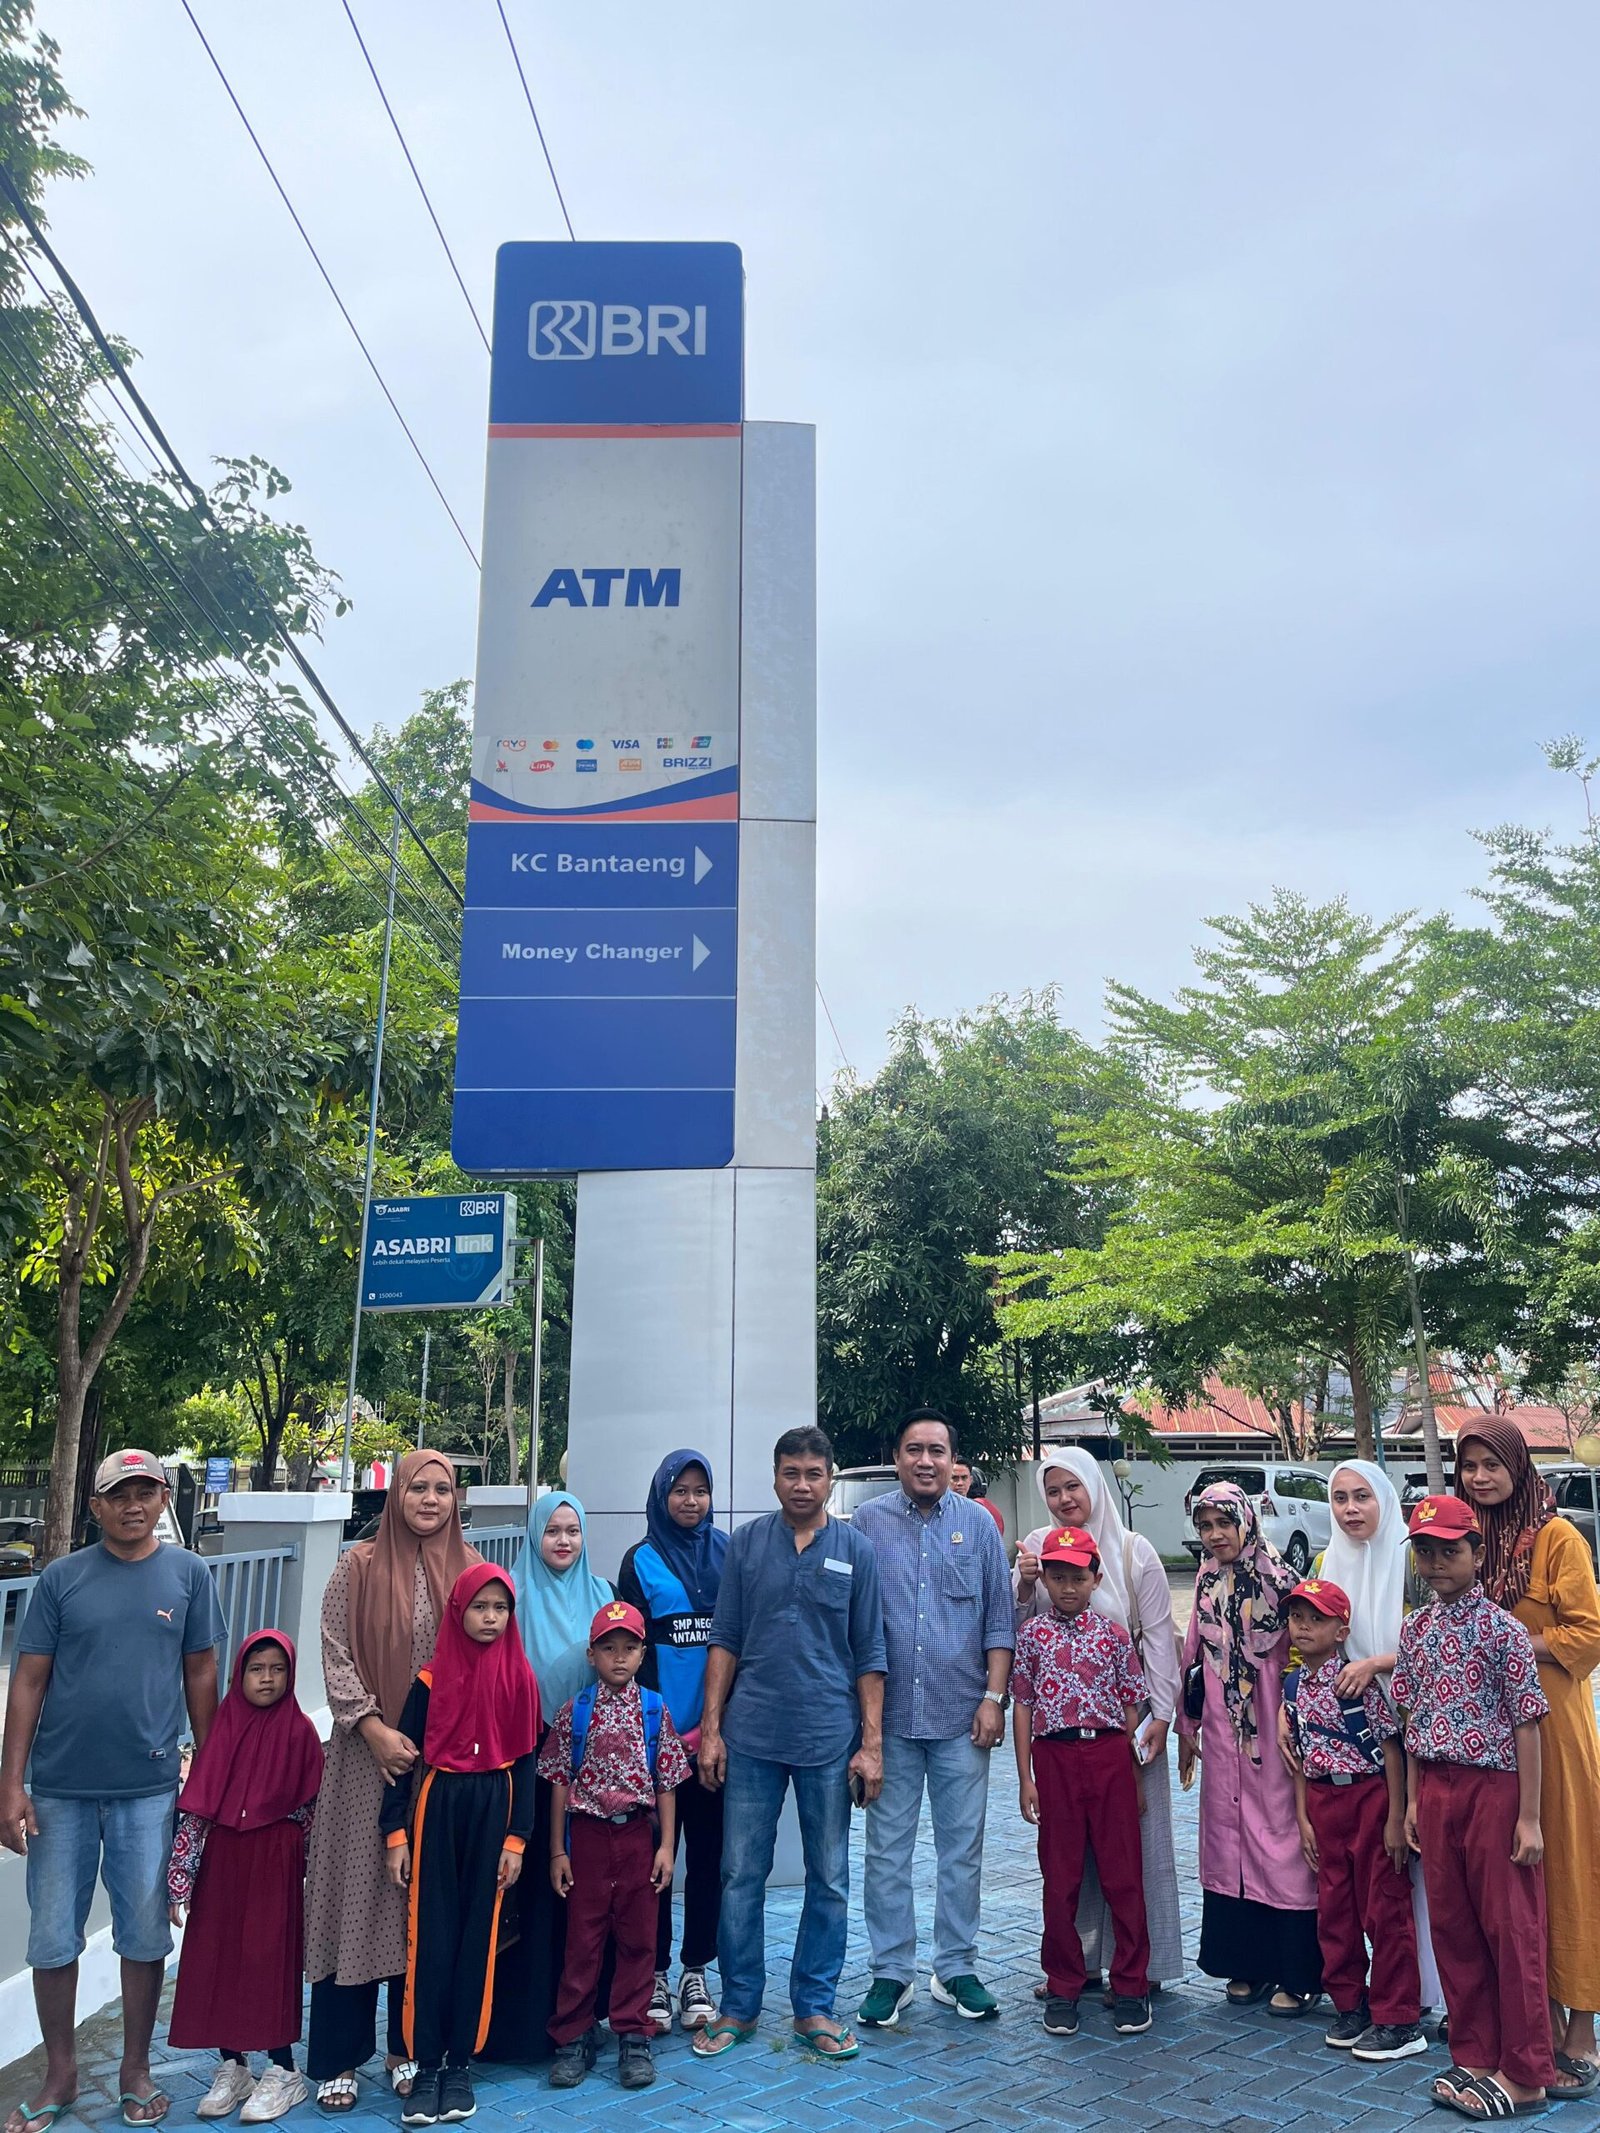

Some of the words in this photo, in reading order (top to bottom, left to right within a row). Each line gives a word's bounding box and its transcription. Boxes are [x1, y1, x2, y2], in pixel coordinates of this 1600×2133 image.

[601, 305, 706, 356] BRI
[530, 568, 681, 608] ATM
[611, 739, 640, 749] VISA
[663, 757, 712, 767] BRIZZI
[511, 853, 547, 873] KC
[557, 853, 685, 877] Bantaeng
[502, 943, 578, 963] Money
[585, 943, 683, 963] Changer
[475, 1201, 499, 1215] BRI
[372, 1237, 450, 1257] ASABRI
[672, 1618, 692, 1630] SMP
[669, 1630, 710, 1643] ANTARA
